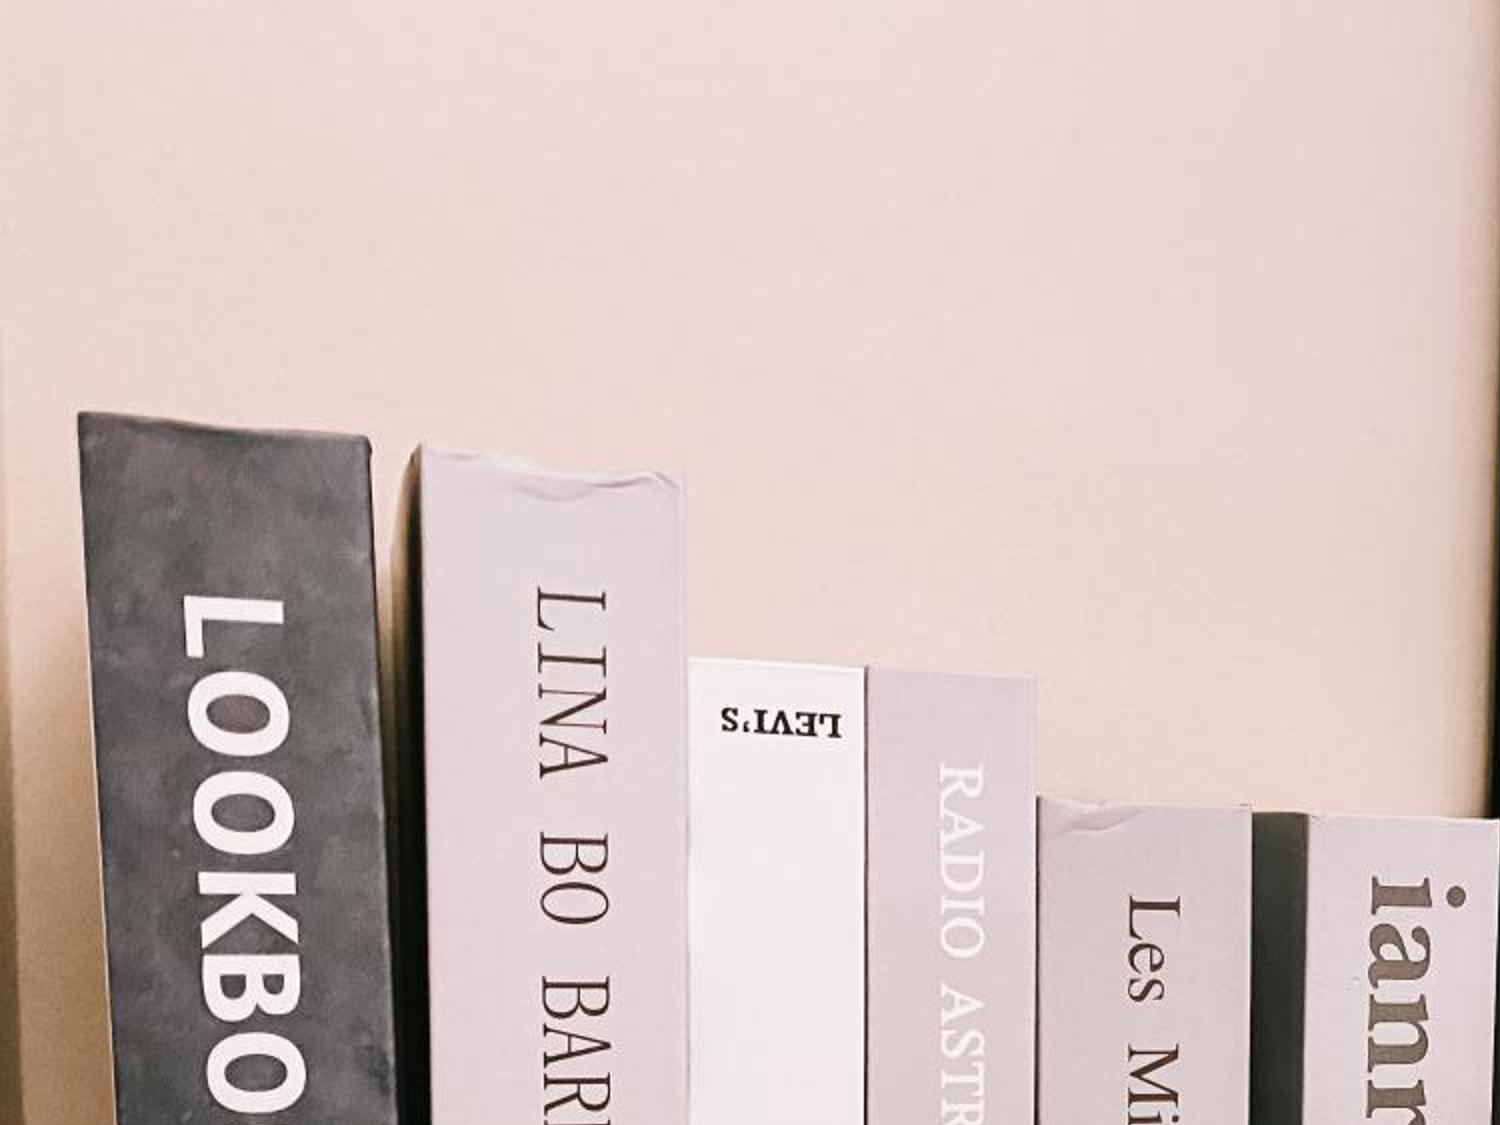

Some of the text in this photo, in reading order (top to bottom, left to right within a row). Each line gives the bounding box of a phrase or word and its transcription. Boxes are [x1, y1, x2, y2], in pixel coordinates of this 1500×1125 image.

[536, 587, 610, 780] LINA
[720, 706, 843, 740] LEVI'S
[539, 831, 611, 926] BO
[940, 763, 987, 960] RADIO
[1128, 896, 1182, 1004] Les
